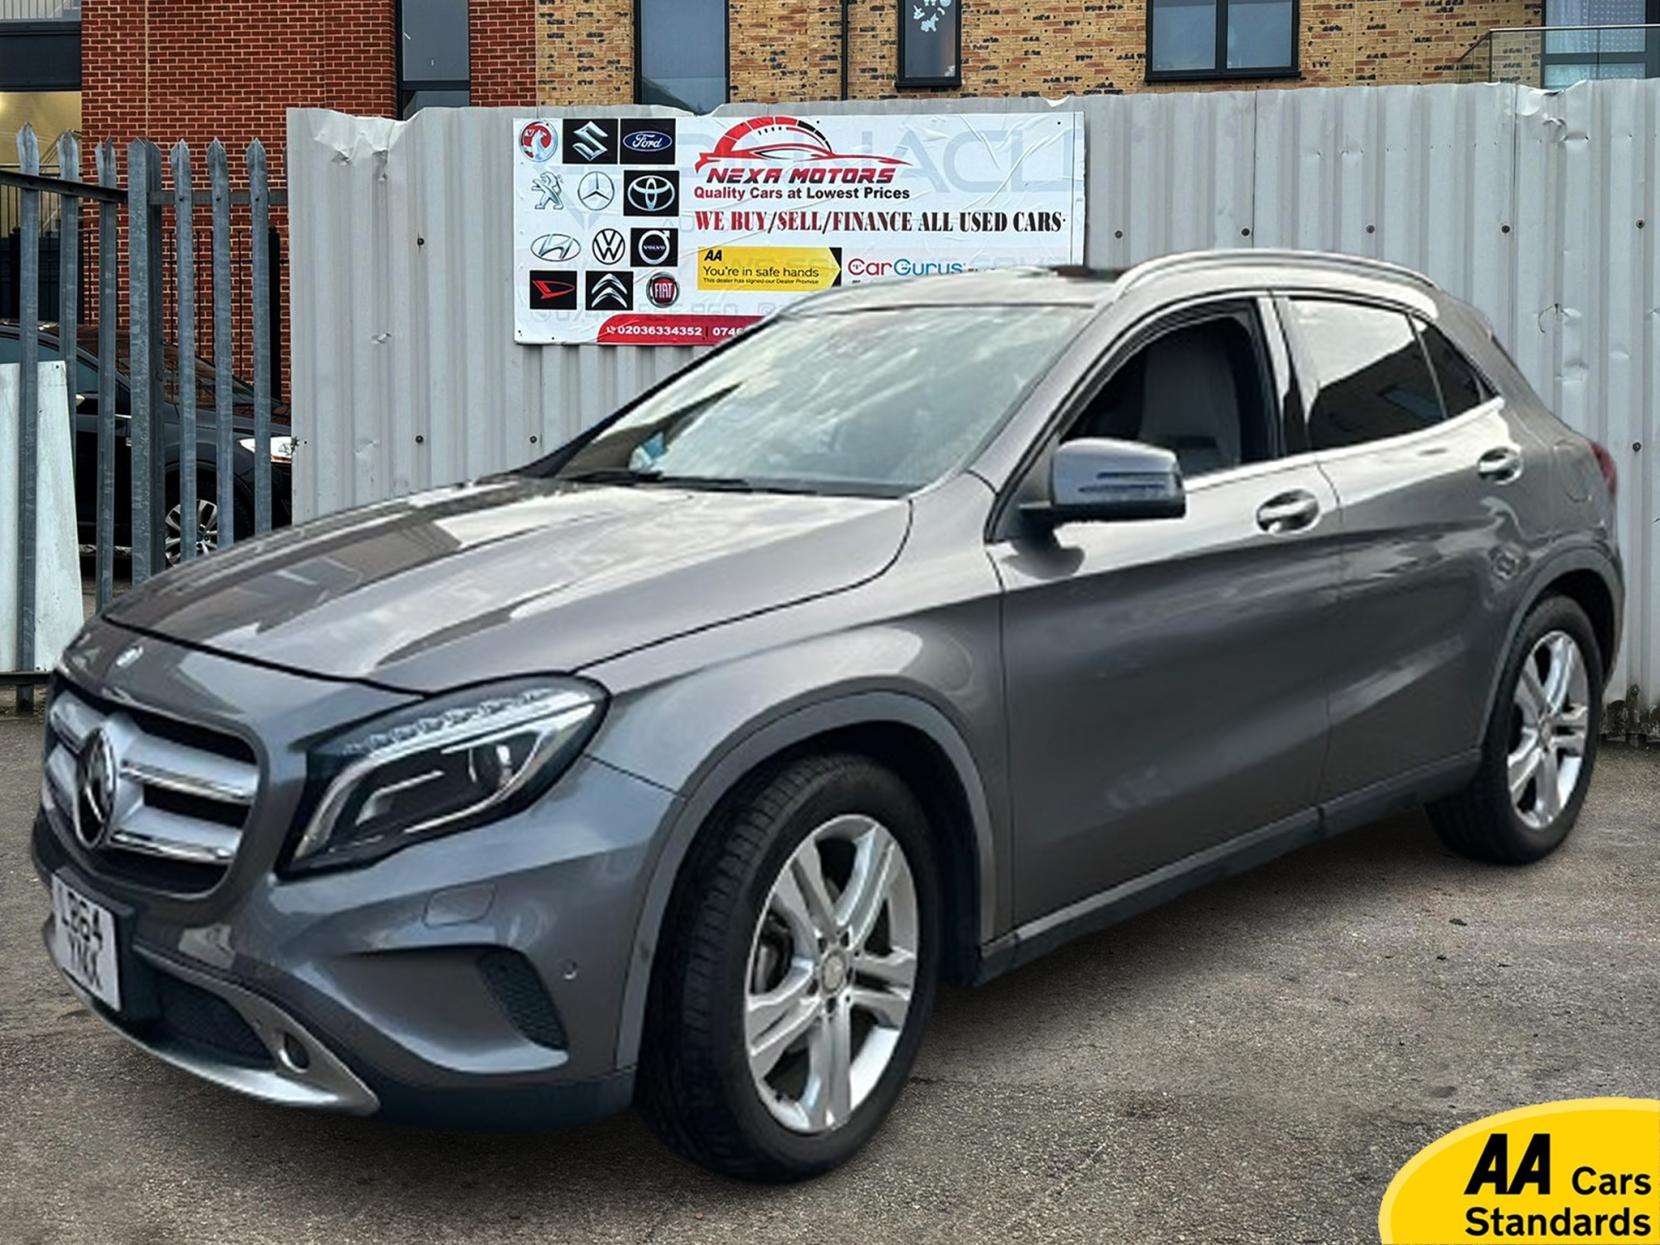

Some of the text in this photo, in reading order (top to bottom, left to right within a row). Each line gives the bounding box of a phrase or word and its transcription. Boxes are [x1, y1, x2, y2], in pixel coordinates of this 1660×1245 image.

[632, 134, 663, 149] Ford
[706, 167, 896, 184] NEXA MOTORS
[694, 186, 910, 201] Quality Cars at Lowest Prices
[695, 211, 725, 231] WE
[918, 211, 953, 232] ALL
[959, 211, 1007, 232] USED
[1013, 211, 1062, 232] CARS
[704, 249, 723, 262] AA
[703, 265, 820, 278] You're in safe hands
[847, 258, 963, 276] CarGurus
[654, 282, 673, 299] FIAT
